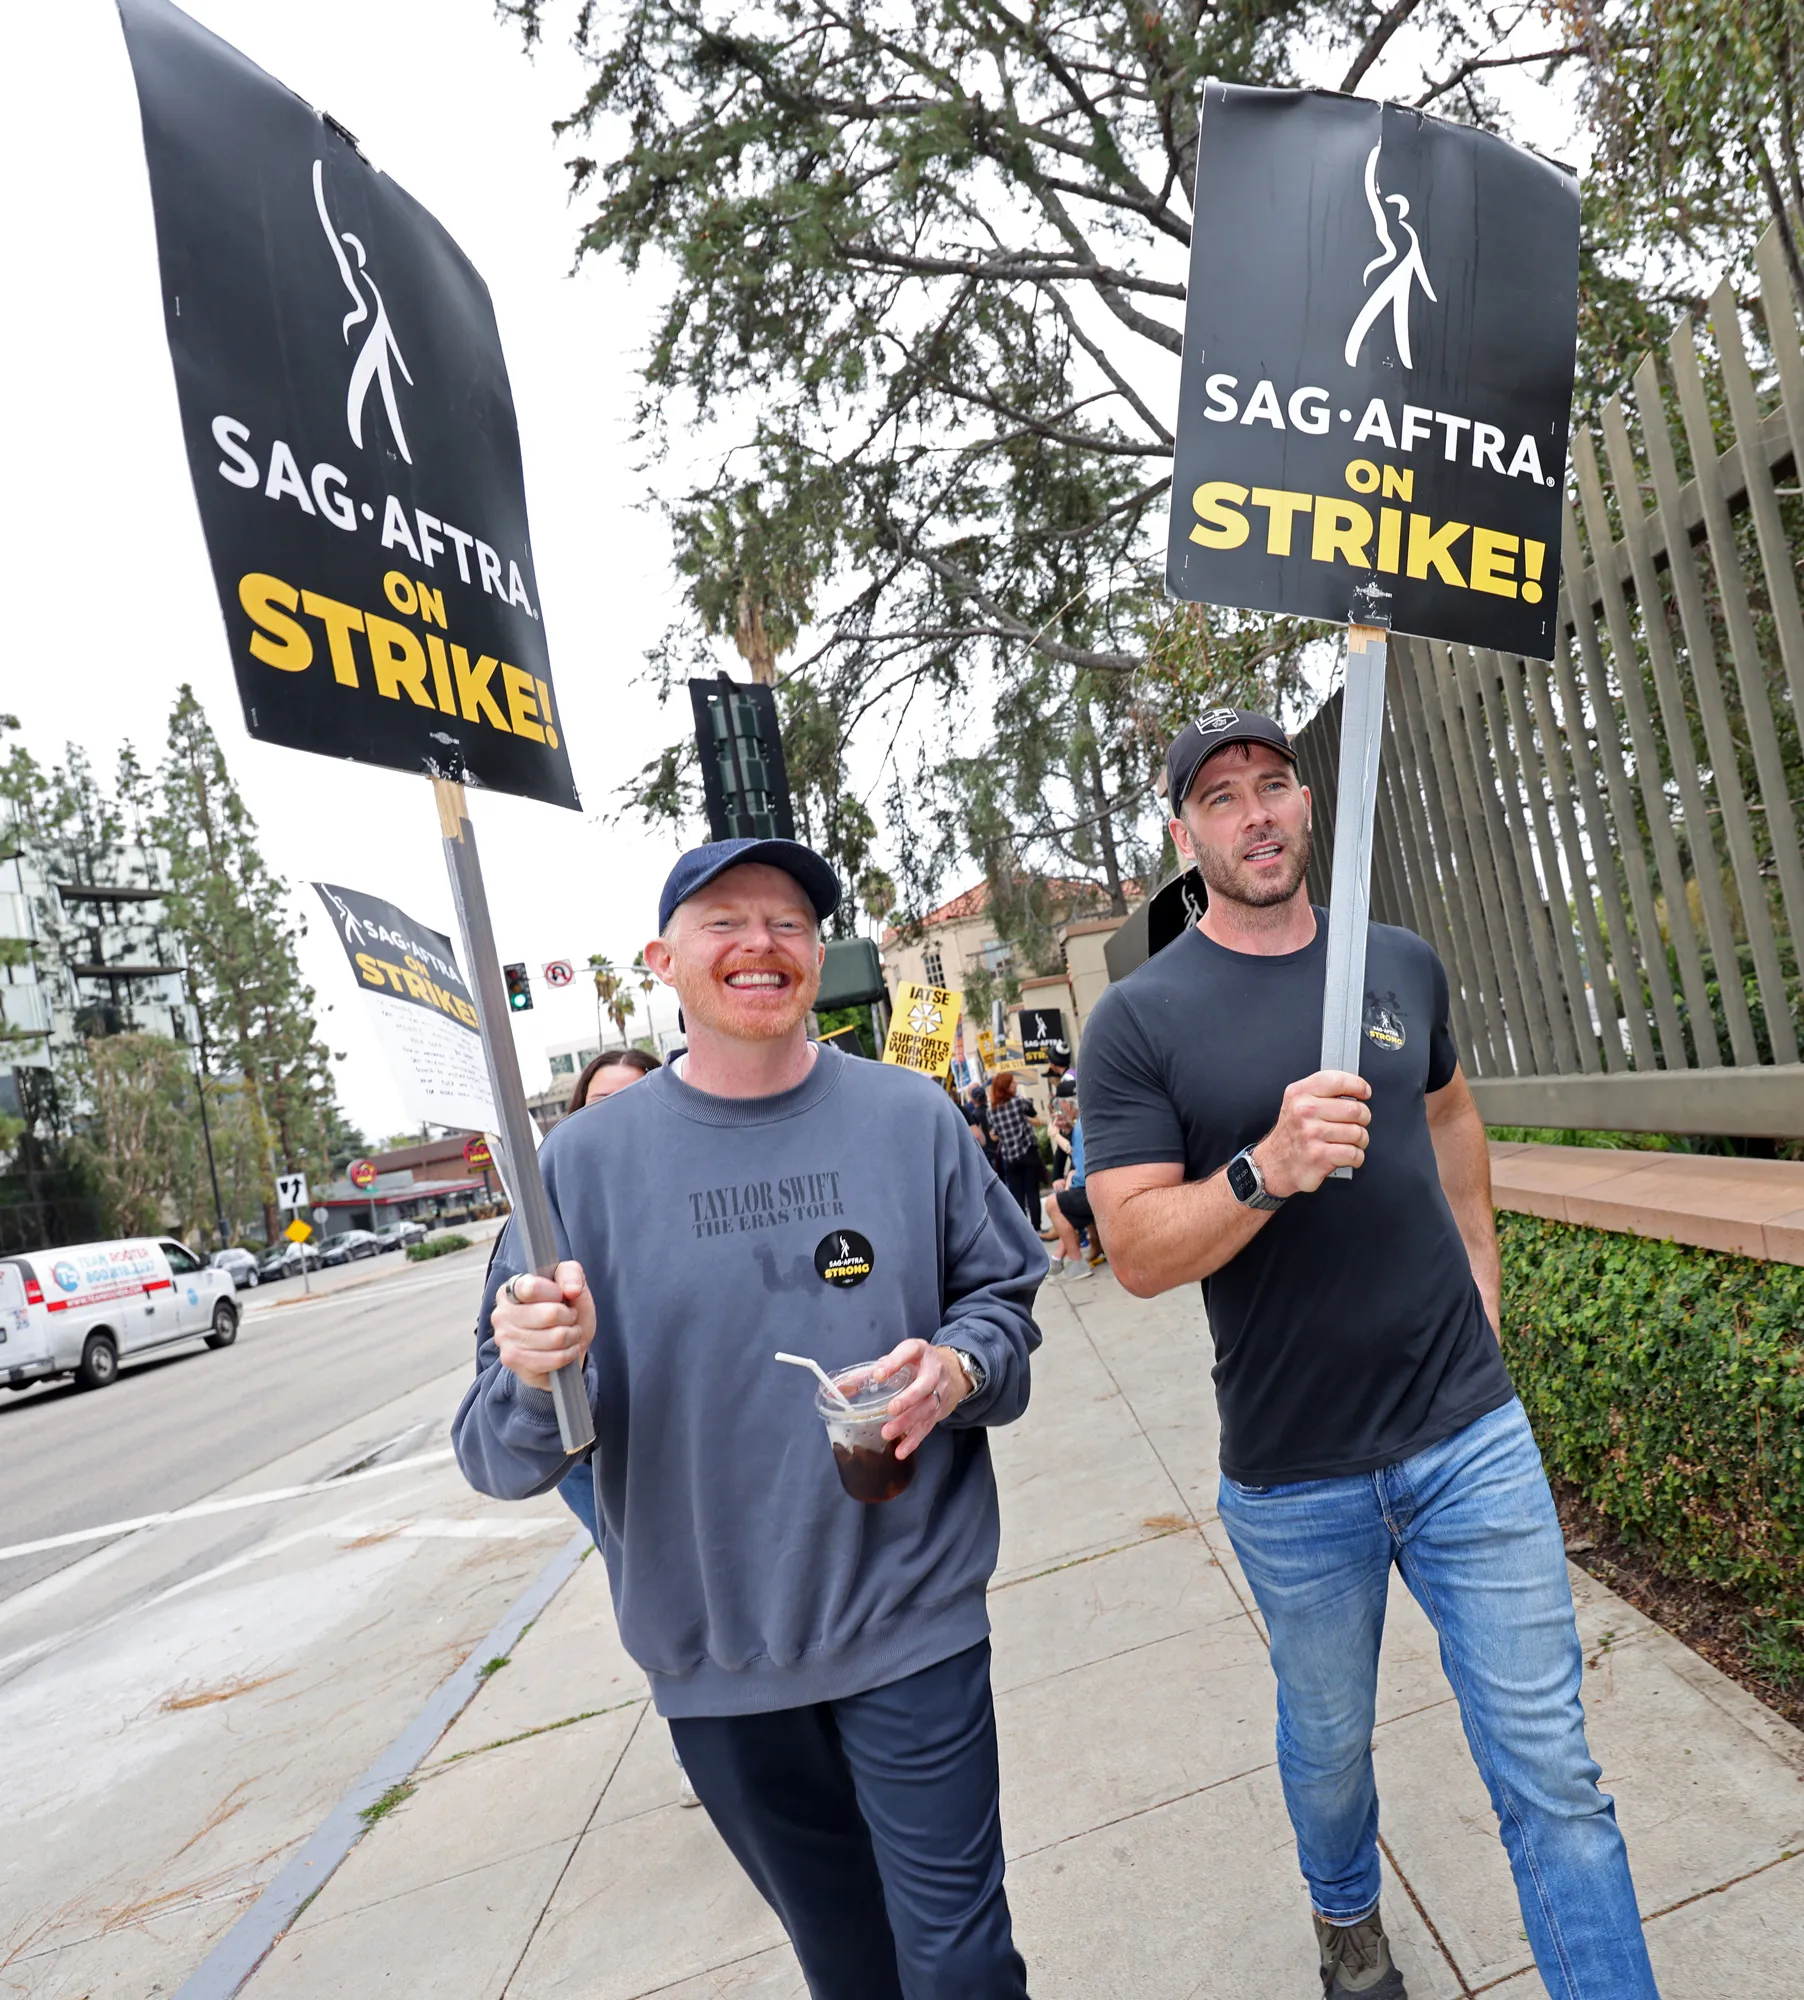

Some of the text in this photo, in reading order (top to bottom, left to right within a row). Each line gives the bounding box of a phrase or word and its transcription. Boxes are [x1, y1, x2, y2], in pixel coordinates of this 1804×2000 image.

[1344, 459, 1414, 503] ON
[1188, 481, 1546, 604] STRIKE!
[383, 570, 448, 629] ON
[238, 572, 559, 749] STRIKE!
[403, 954, 431, 979] ON
[355, 952, 480, 1029] STRIKE!
[909, 986, 951, 1006] IATSE
[888, 1041, 949, 1062] WORKERS'
[890, 1031, 950, 1053] SUPPORTS
[1369, 1030, 1403, 1045] STRONG
[895, 1054, 938, 1071] RIGHTS
[688, 1171, 841, 1223] TAYLOR SWIFT
[691, 1201, 845, 1239] THE ERAS TOUR
[824, 1263, 870, 1279] STRONG
